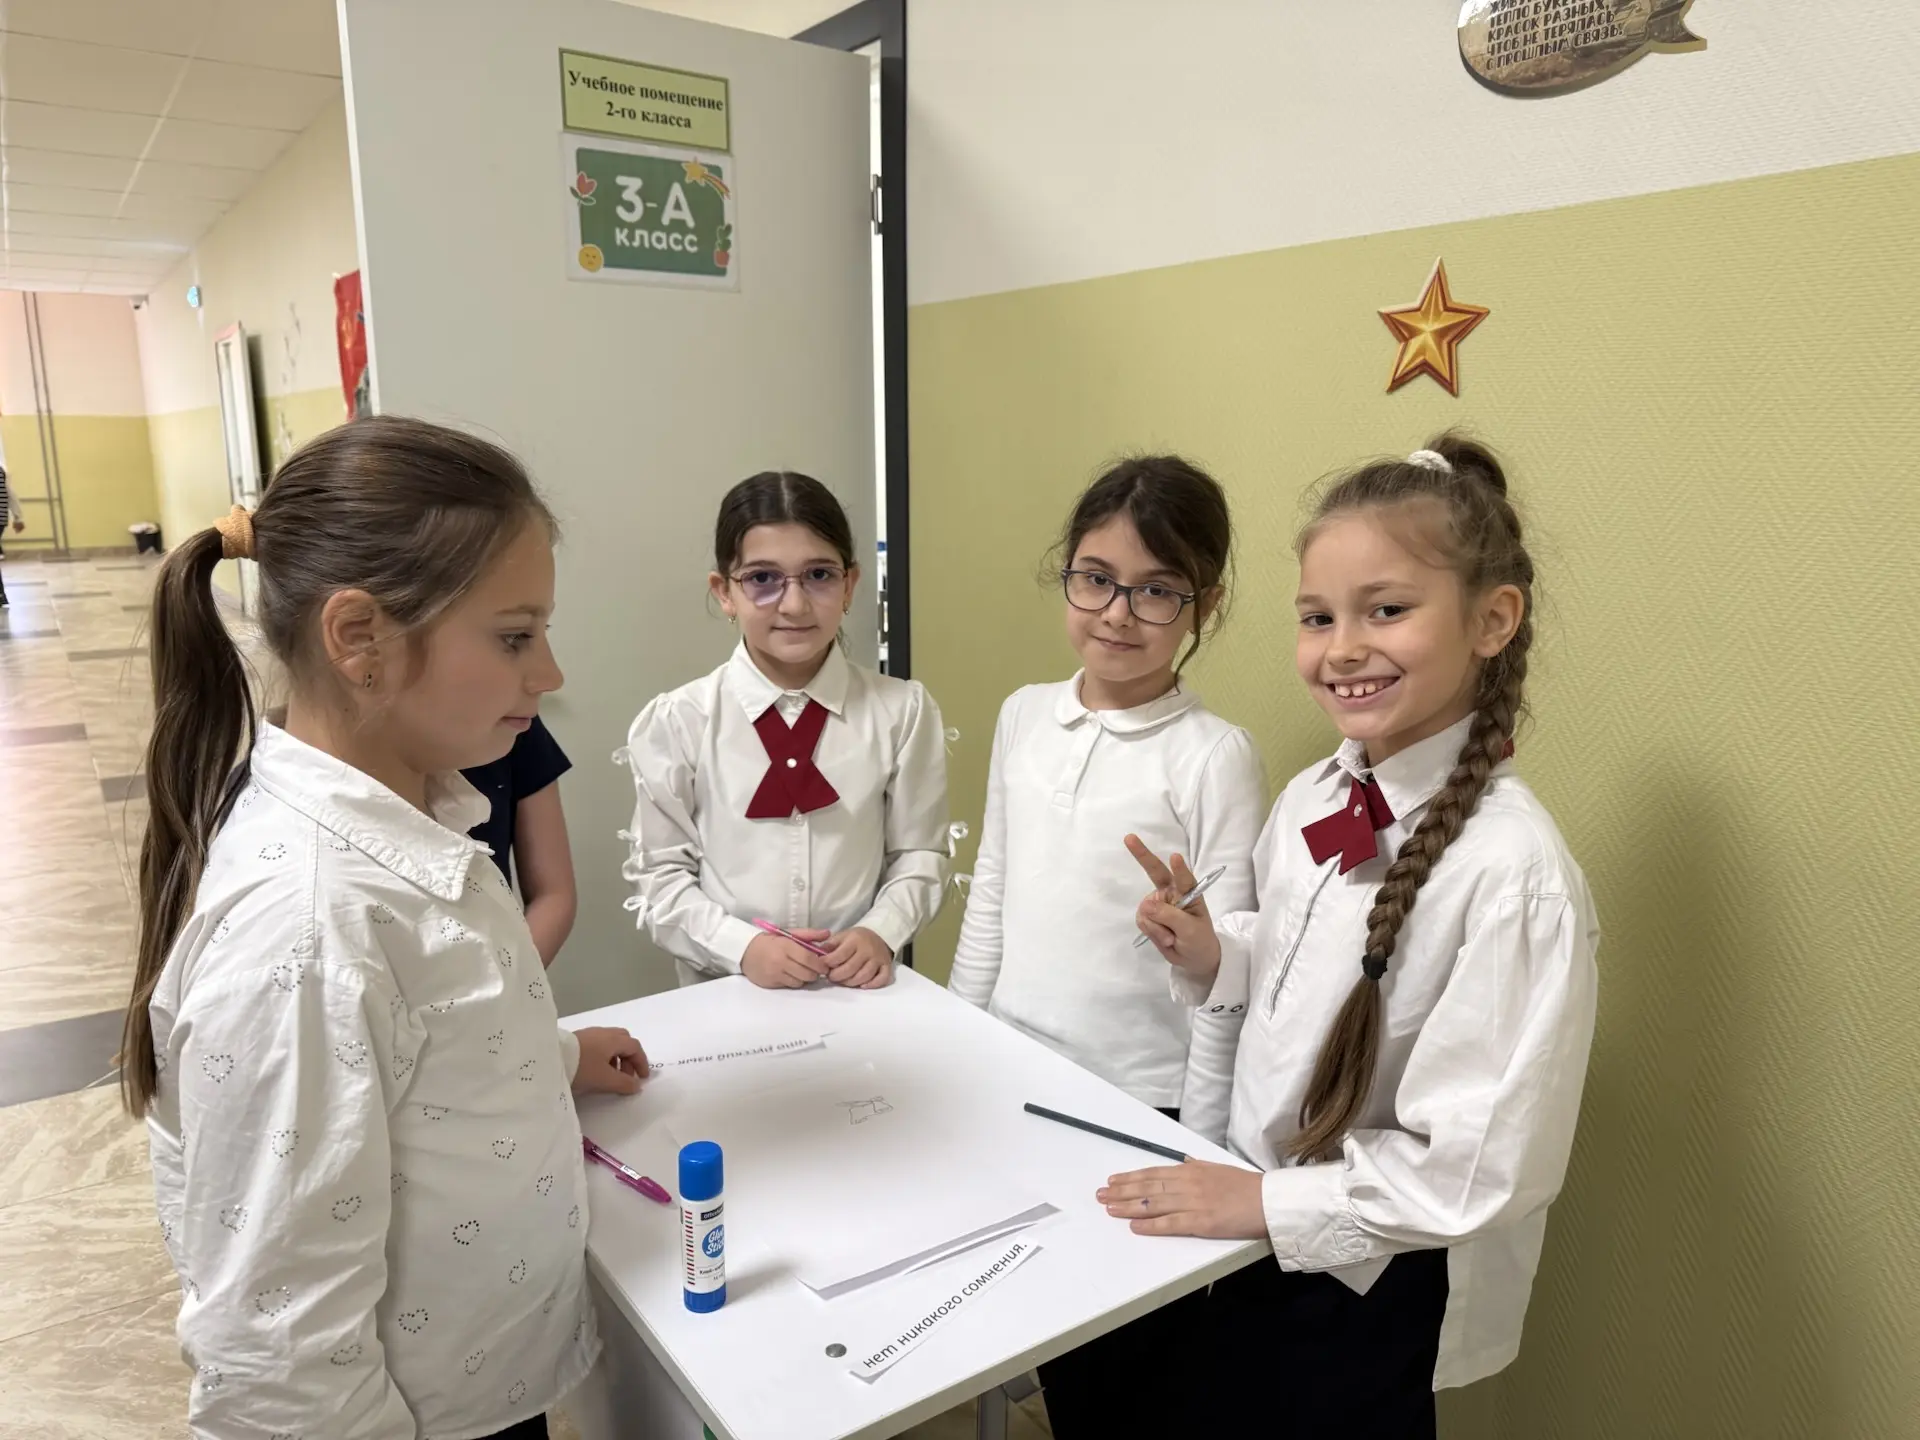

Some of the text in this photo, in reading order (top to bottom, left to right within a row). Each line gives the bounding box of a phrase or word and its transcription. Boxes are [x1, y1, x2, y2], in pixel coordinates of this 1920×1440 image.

[1487, 17, 1540, 43] КРАСОК
[1490, 5, 1530, 29] ТЕПЛО
[1487, 11, 1615, 56] ЧТОБ НЕ ТЕРЯЛАСЬ
[1486, 58, 1494, 70] С
[1496, 38, 1569, 68] ПРОШЛЫМ
[568, 70, 724, 112] Учебное помещение
[605, 101, 692, 129] 2-го класса
[615, 175, 695, 229] 3-А
[615, 226, 698, 253] класс
[677, 1055, 713, 1067] язык
[706, 1237, 724, 1255] Stic
[863, 1242, 1028, 1369] нет никакого сомнения.
